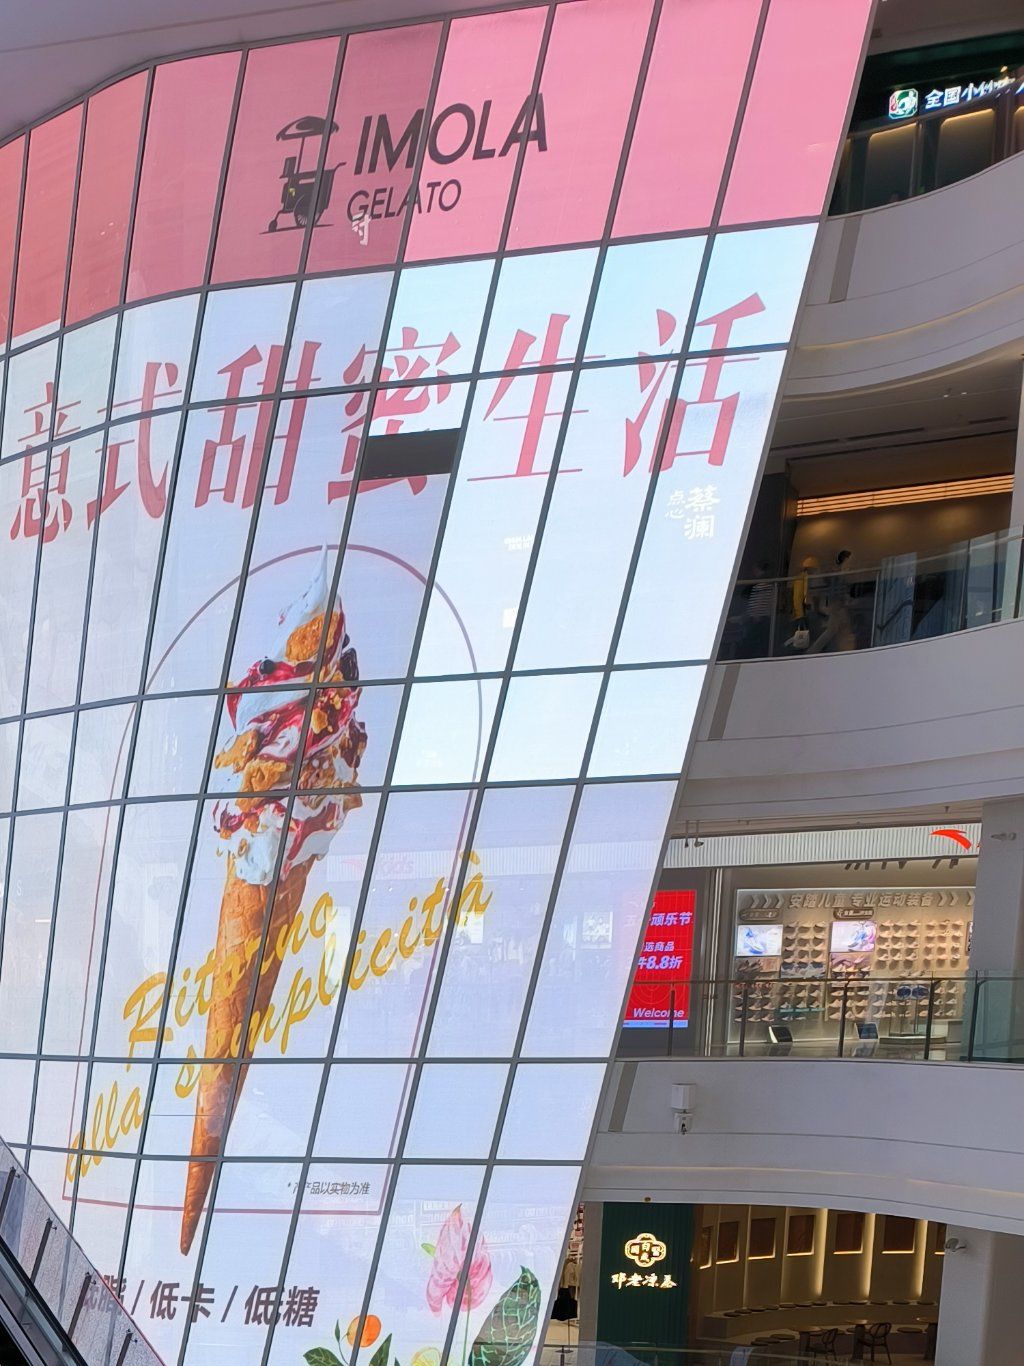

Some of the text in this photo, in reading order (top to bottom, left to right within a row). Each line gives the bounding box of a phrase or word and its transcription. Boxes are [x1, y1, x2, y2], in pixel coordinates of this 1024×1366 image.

[354, 92, 548, 175] IMOLA
[347, 178, 462, 221] GELATO
[10, 292, 766, 543] 意式甜蜜生活
